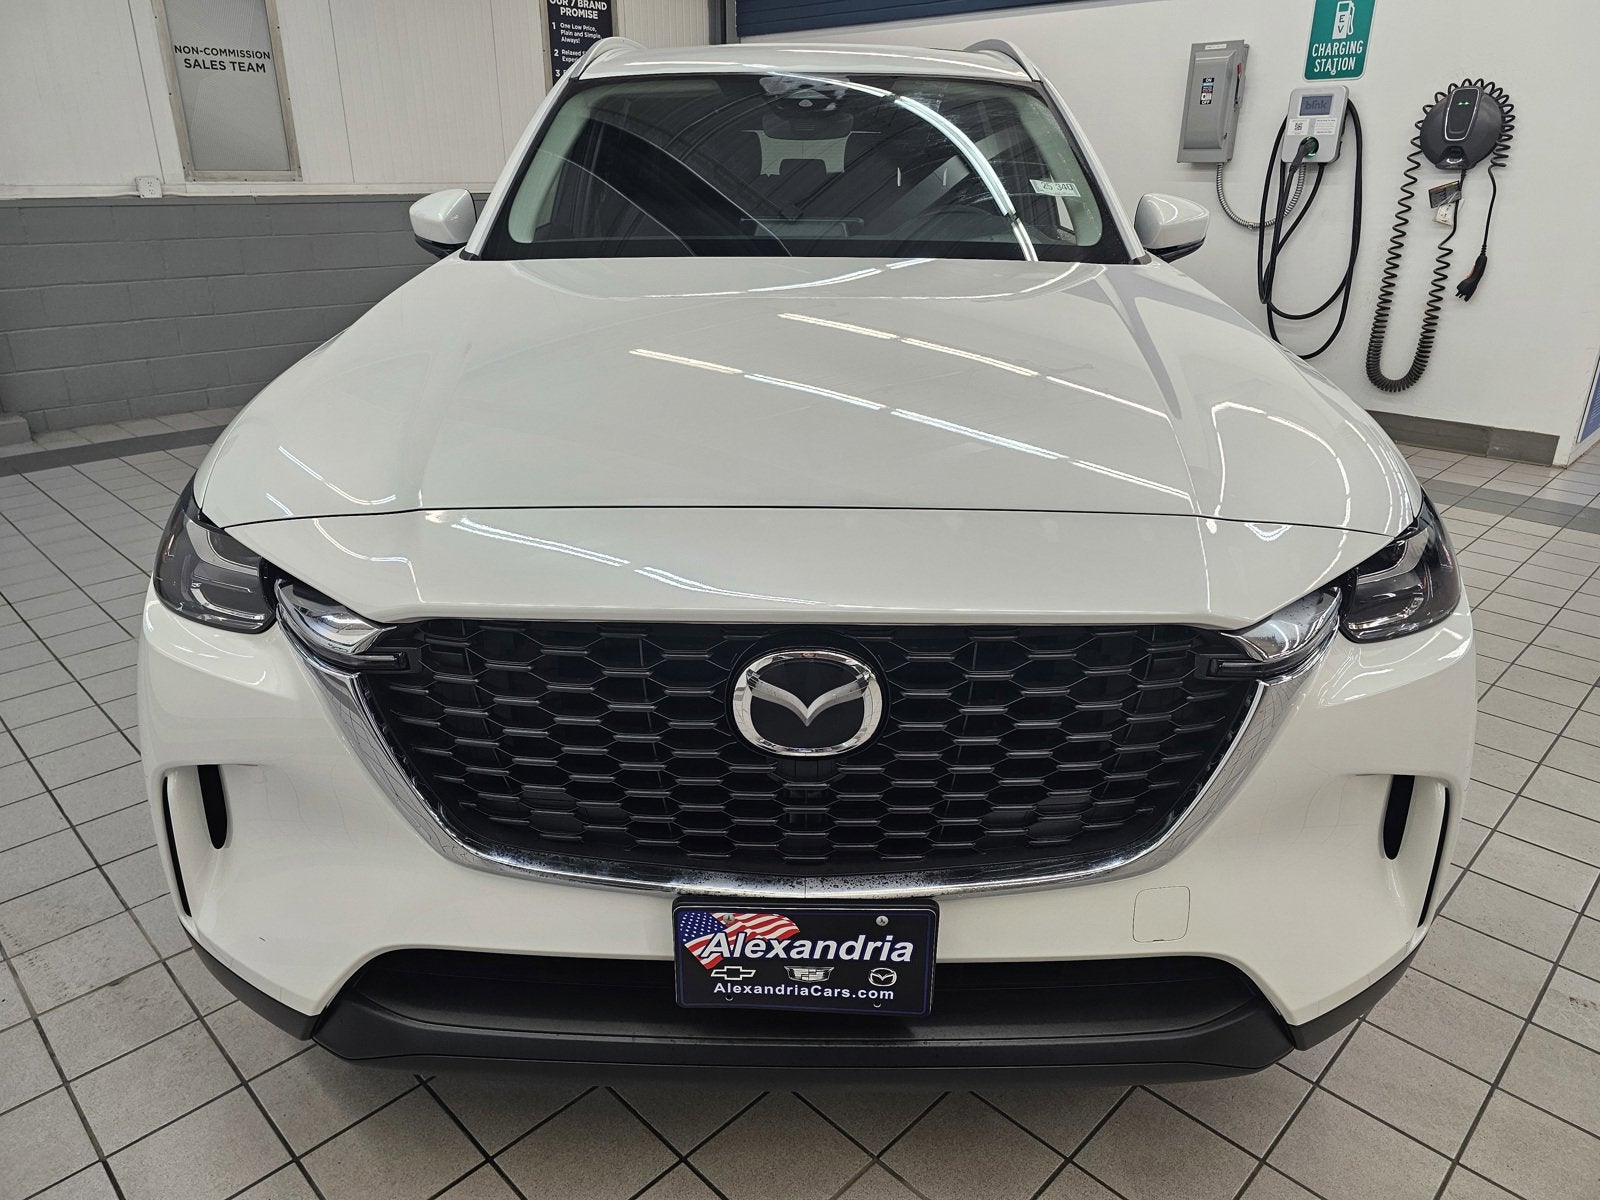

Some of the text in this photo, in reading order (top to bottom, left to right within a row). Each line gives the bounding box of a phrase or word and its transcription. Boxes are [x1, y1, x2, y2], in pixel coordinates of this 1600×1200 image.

[578, 0, 607, 10] BRAND
[560, 7, 598, 19] PROMISE
[552, 22, 556, 30] 1
[174, 45, 271, 60] NON-COMMISSION
[554, 49, 559, 57] 2
[1312, 40, 1364, 57] CHARGING
[184, 58, 266, 73] SALES TEAM
[1313, 57, 1356, 72] STATION
[555, 69, 561, 77] 3
[1305, 100, 1328, 110] blink
[1055, 183, 1074, 191] 340
[701, 932, 914, 962] Alexandria
[714, 982, 895, 1000] AlexandriaCars.com
